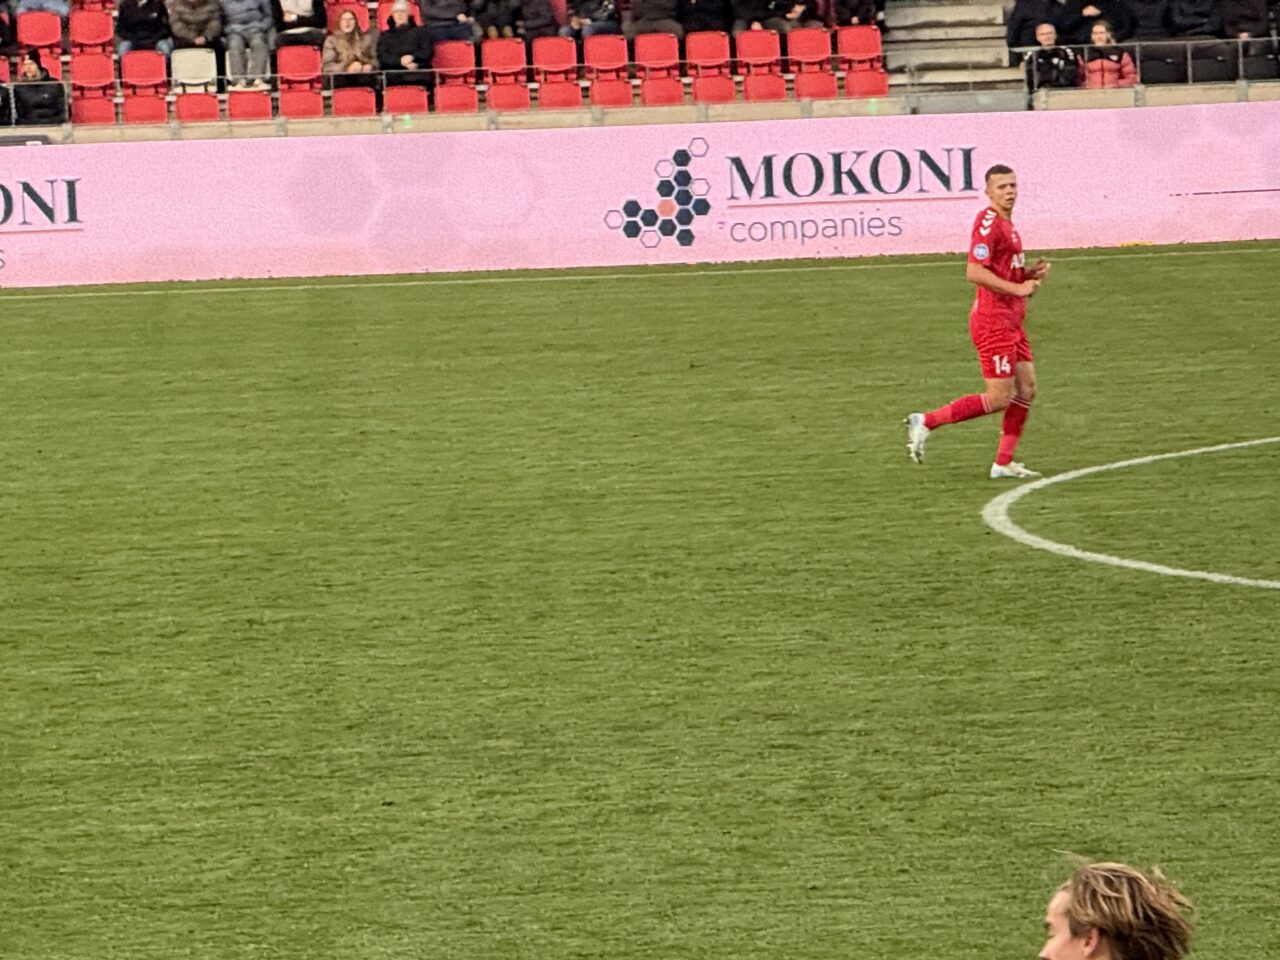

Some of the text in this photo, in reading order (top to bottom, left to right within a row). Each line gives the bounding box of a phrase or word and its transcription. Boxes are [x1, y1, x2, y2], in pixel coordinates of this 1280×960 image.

[726, 146, 979, 200] MOKONI
[729, 212, 903, 246] companies
[992, 354, 1012, 376] 14
